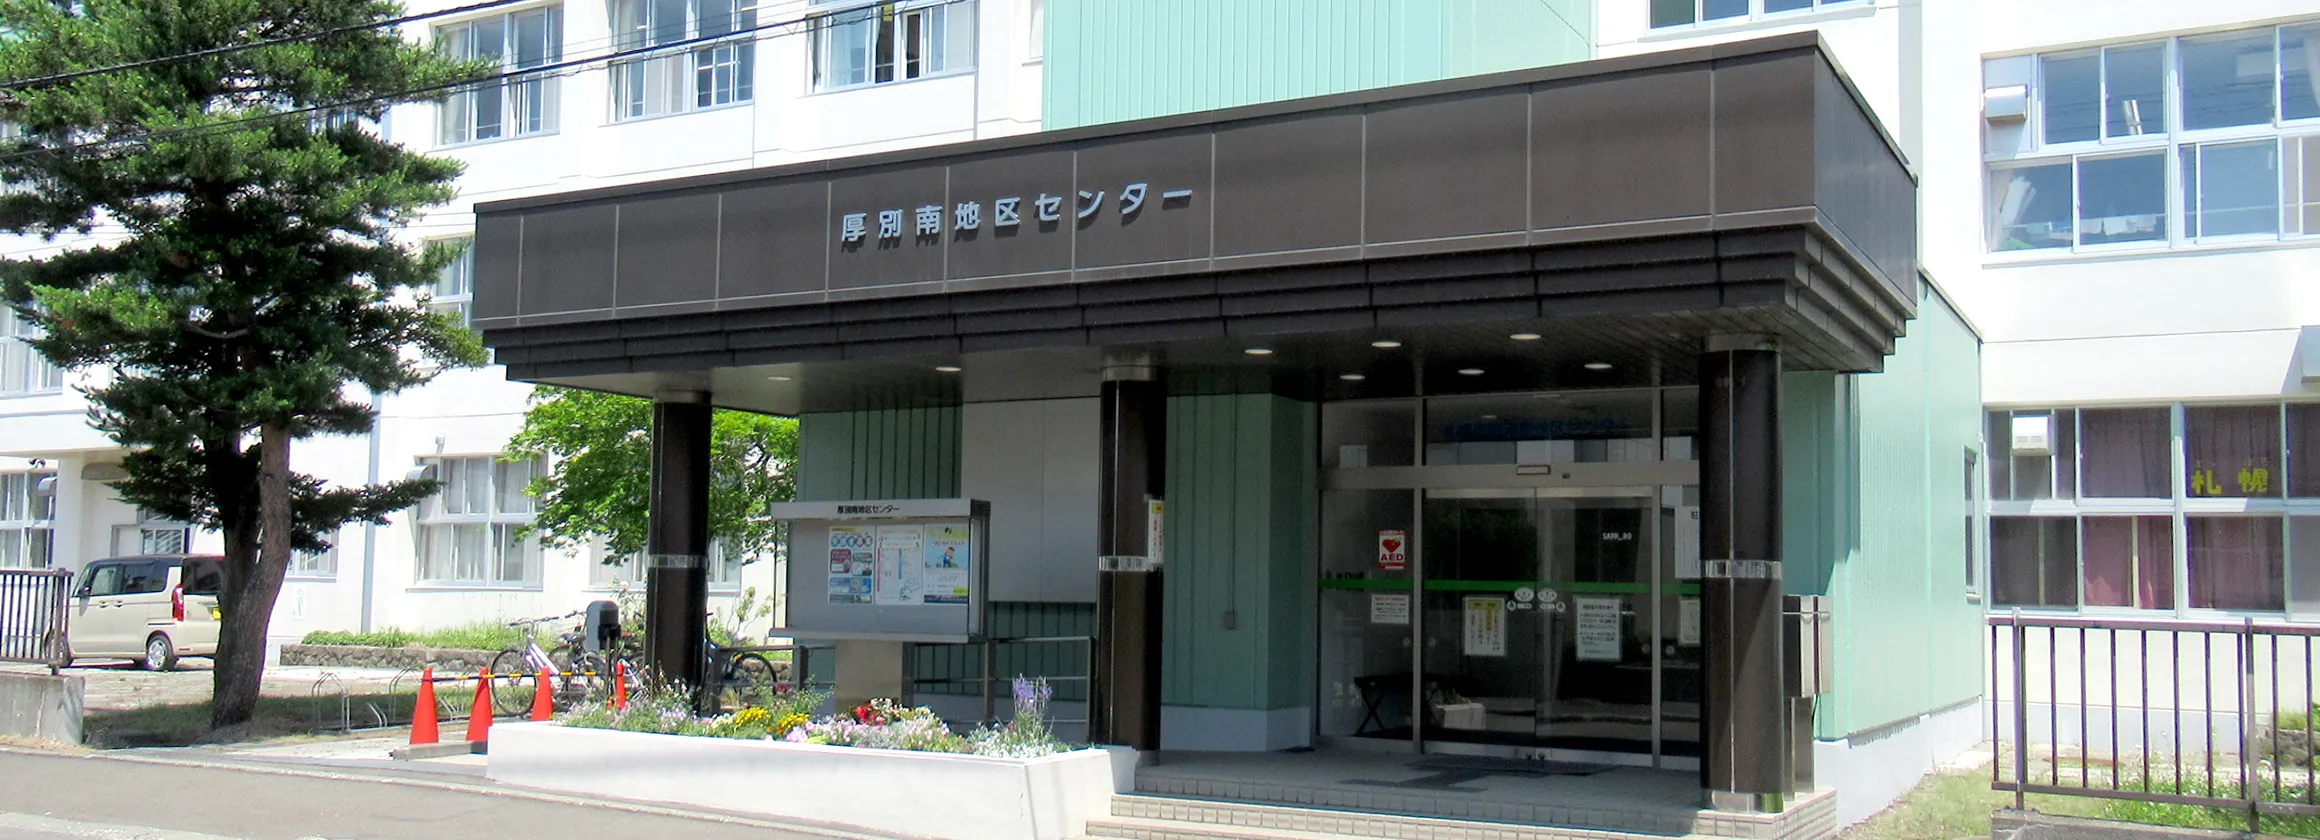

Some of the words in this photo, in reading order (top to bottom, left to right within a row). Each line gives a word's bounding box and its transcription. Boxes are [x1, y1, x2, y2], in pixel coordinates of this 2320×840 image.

[841, 183, 1193, 243] 厚別南地区センター
[2191, 468, 2269, 494] 札幌
[1380, 553, 1404, 561] AED
